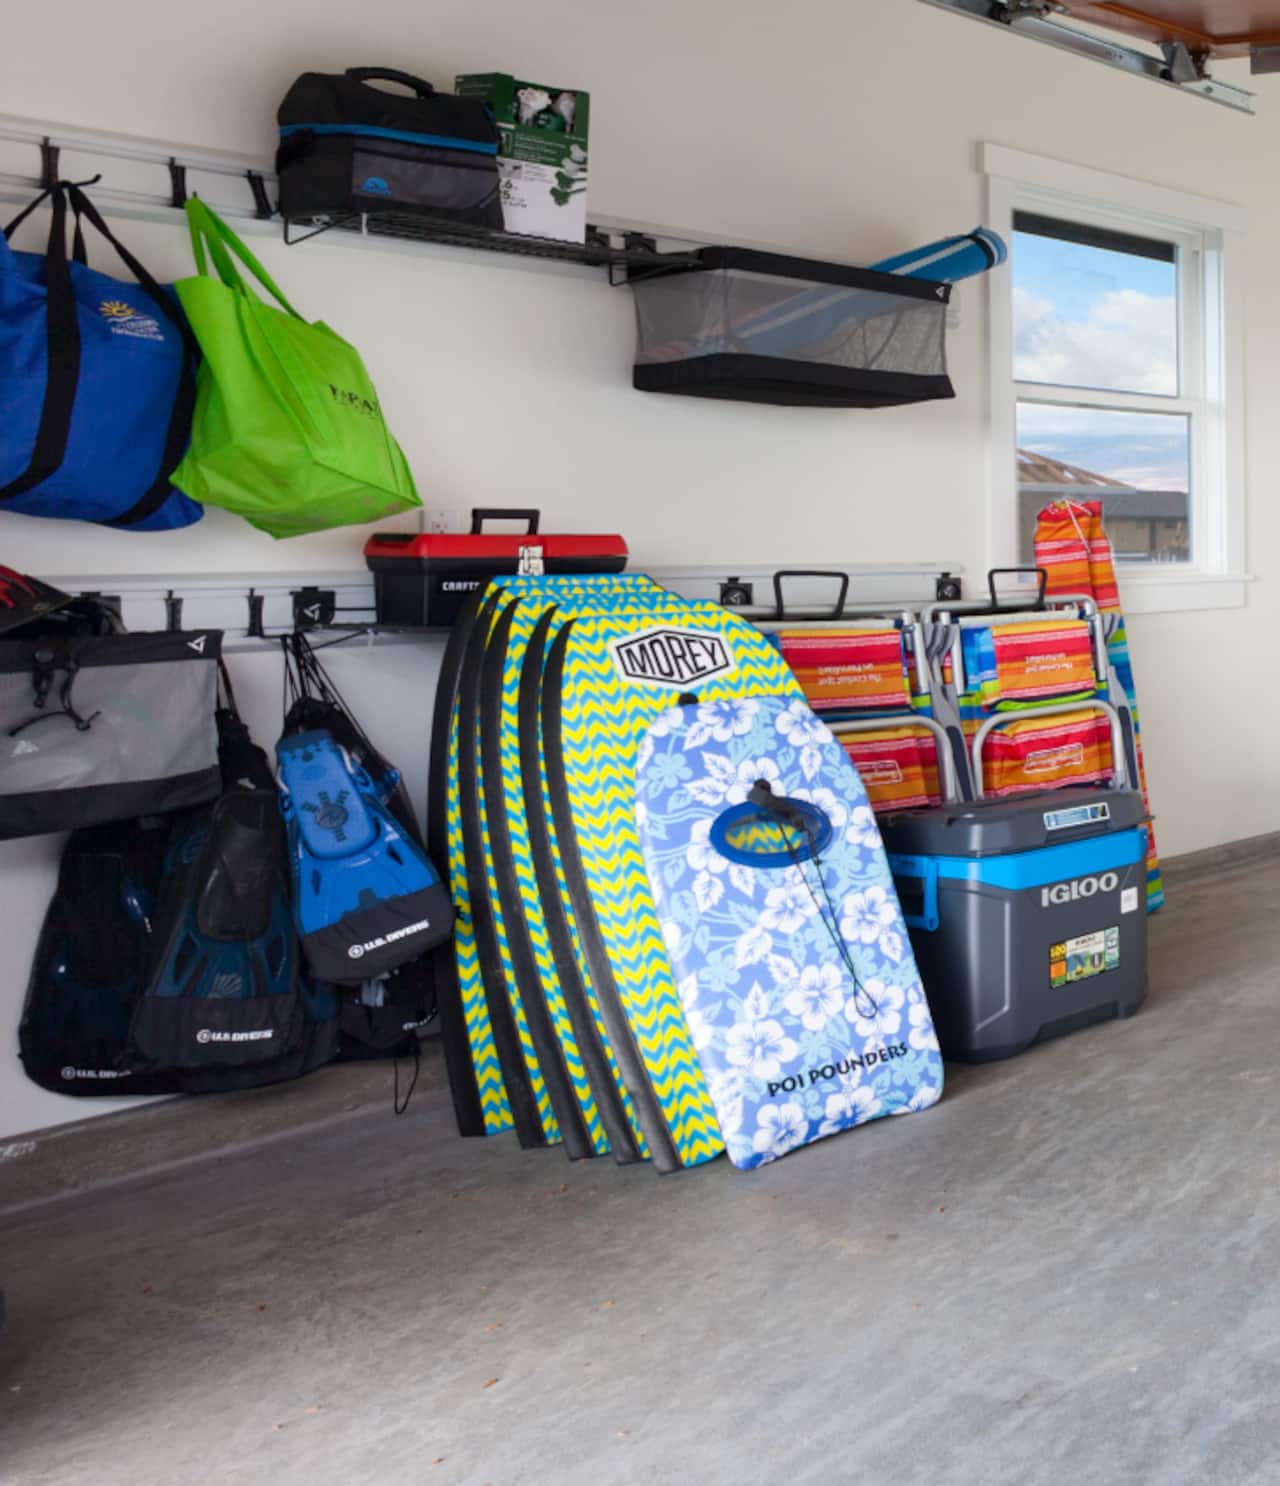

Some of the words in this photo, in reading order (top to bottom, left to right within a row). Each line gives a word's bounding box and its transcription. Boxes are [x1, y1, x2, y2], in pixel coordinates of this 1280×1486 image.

[625, 635, 718, 680] MOREY
[1041, 872, 1118, 907] IGLOO
[386, 919, 430, 943] DIVERS
[767, 1075, 805, 1097] POI
[808, 1042, 908, 1084] POUNDERS
